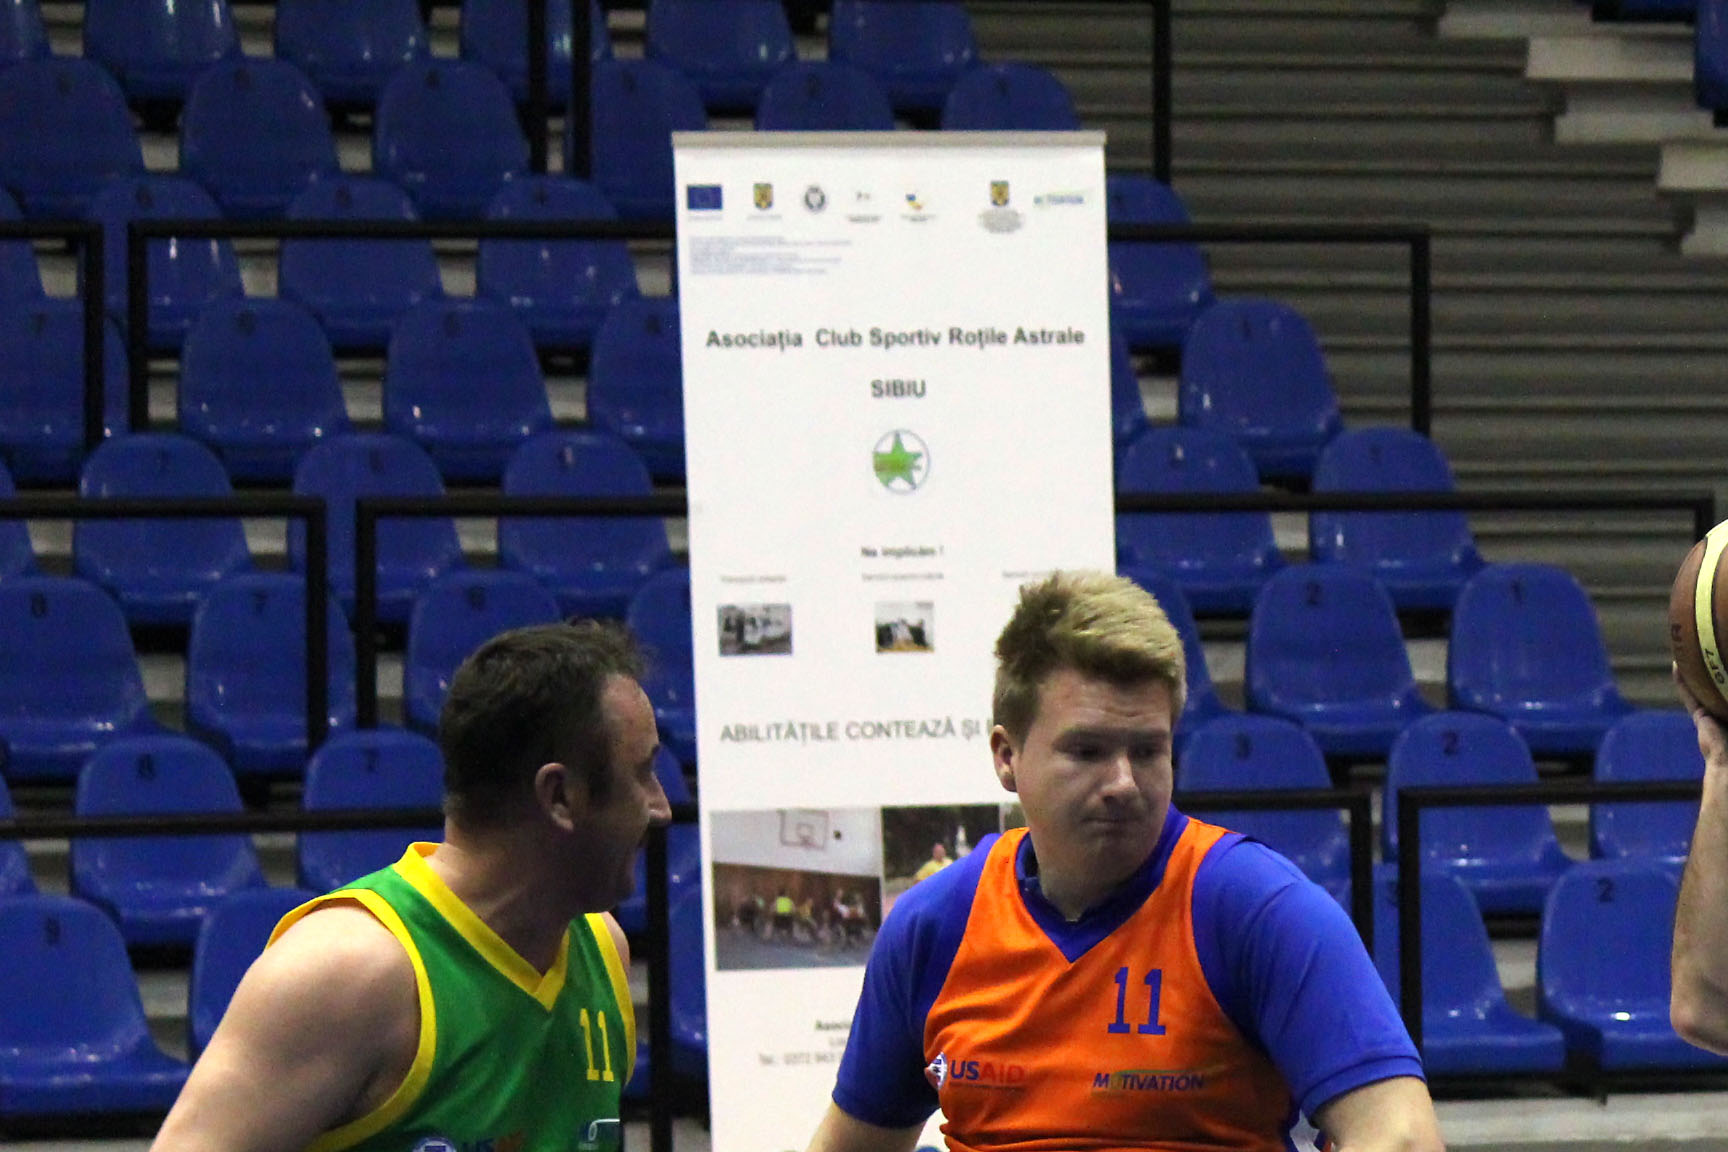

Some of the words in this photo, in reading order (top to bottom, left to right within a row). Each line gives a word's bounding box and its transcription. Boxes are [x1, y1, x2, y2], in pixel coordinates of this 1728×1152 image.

[815, 327, 863, 347] Club
[869, 326, 942, 349] Sportiv
[1013, 326, 1086, 346] Astrale
[871, 379, 927, 398] SIBIU
[1441, 730, 1460, 758] 2
[1596, 877, 1614, 903] 2
[1107, 966, 1167, 1036] 11
[579, 1007, 615, 1082] 11
[950, 1059, 1026, 1084] USAID
